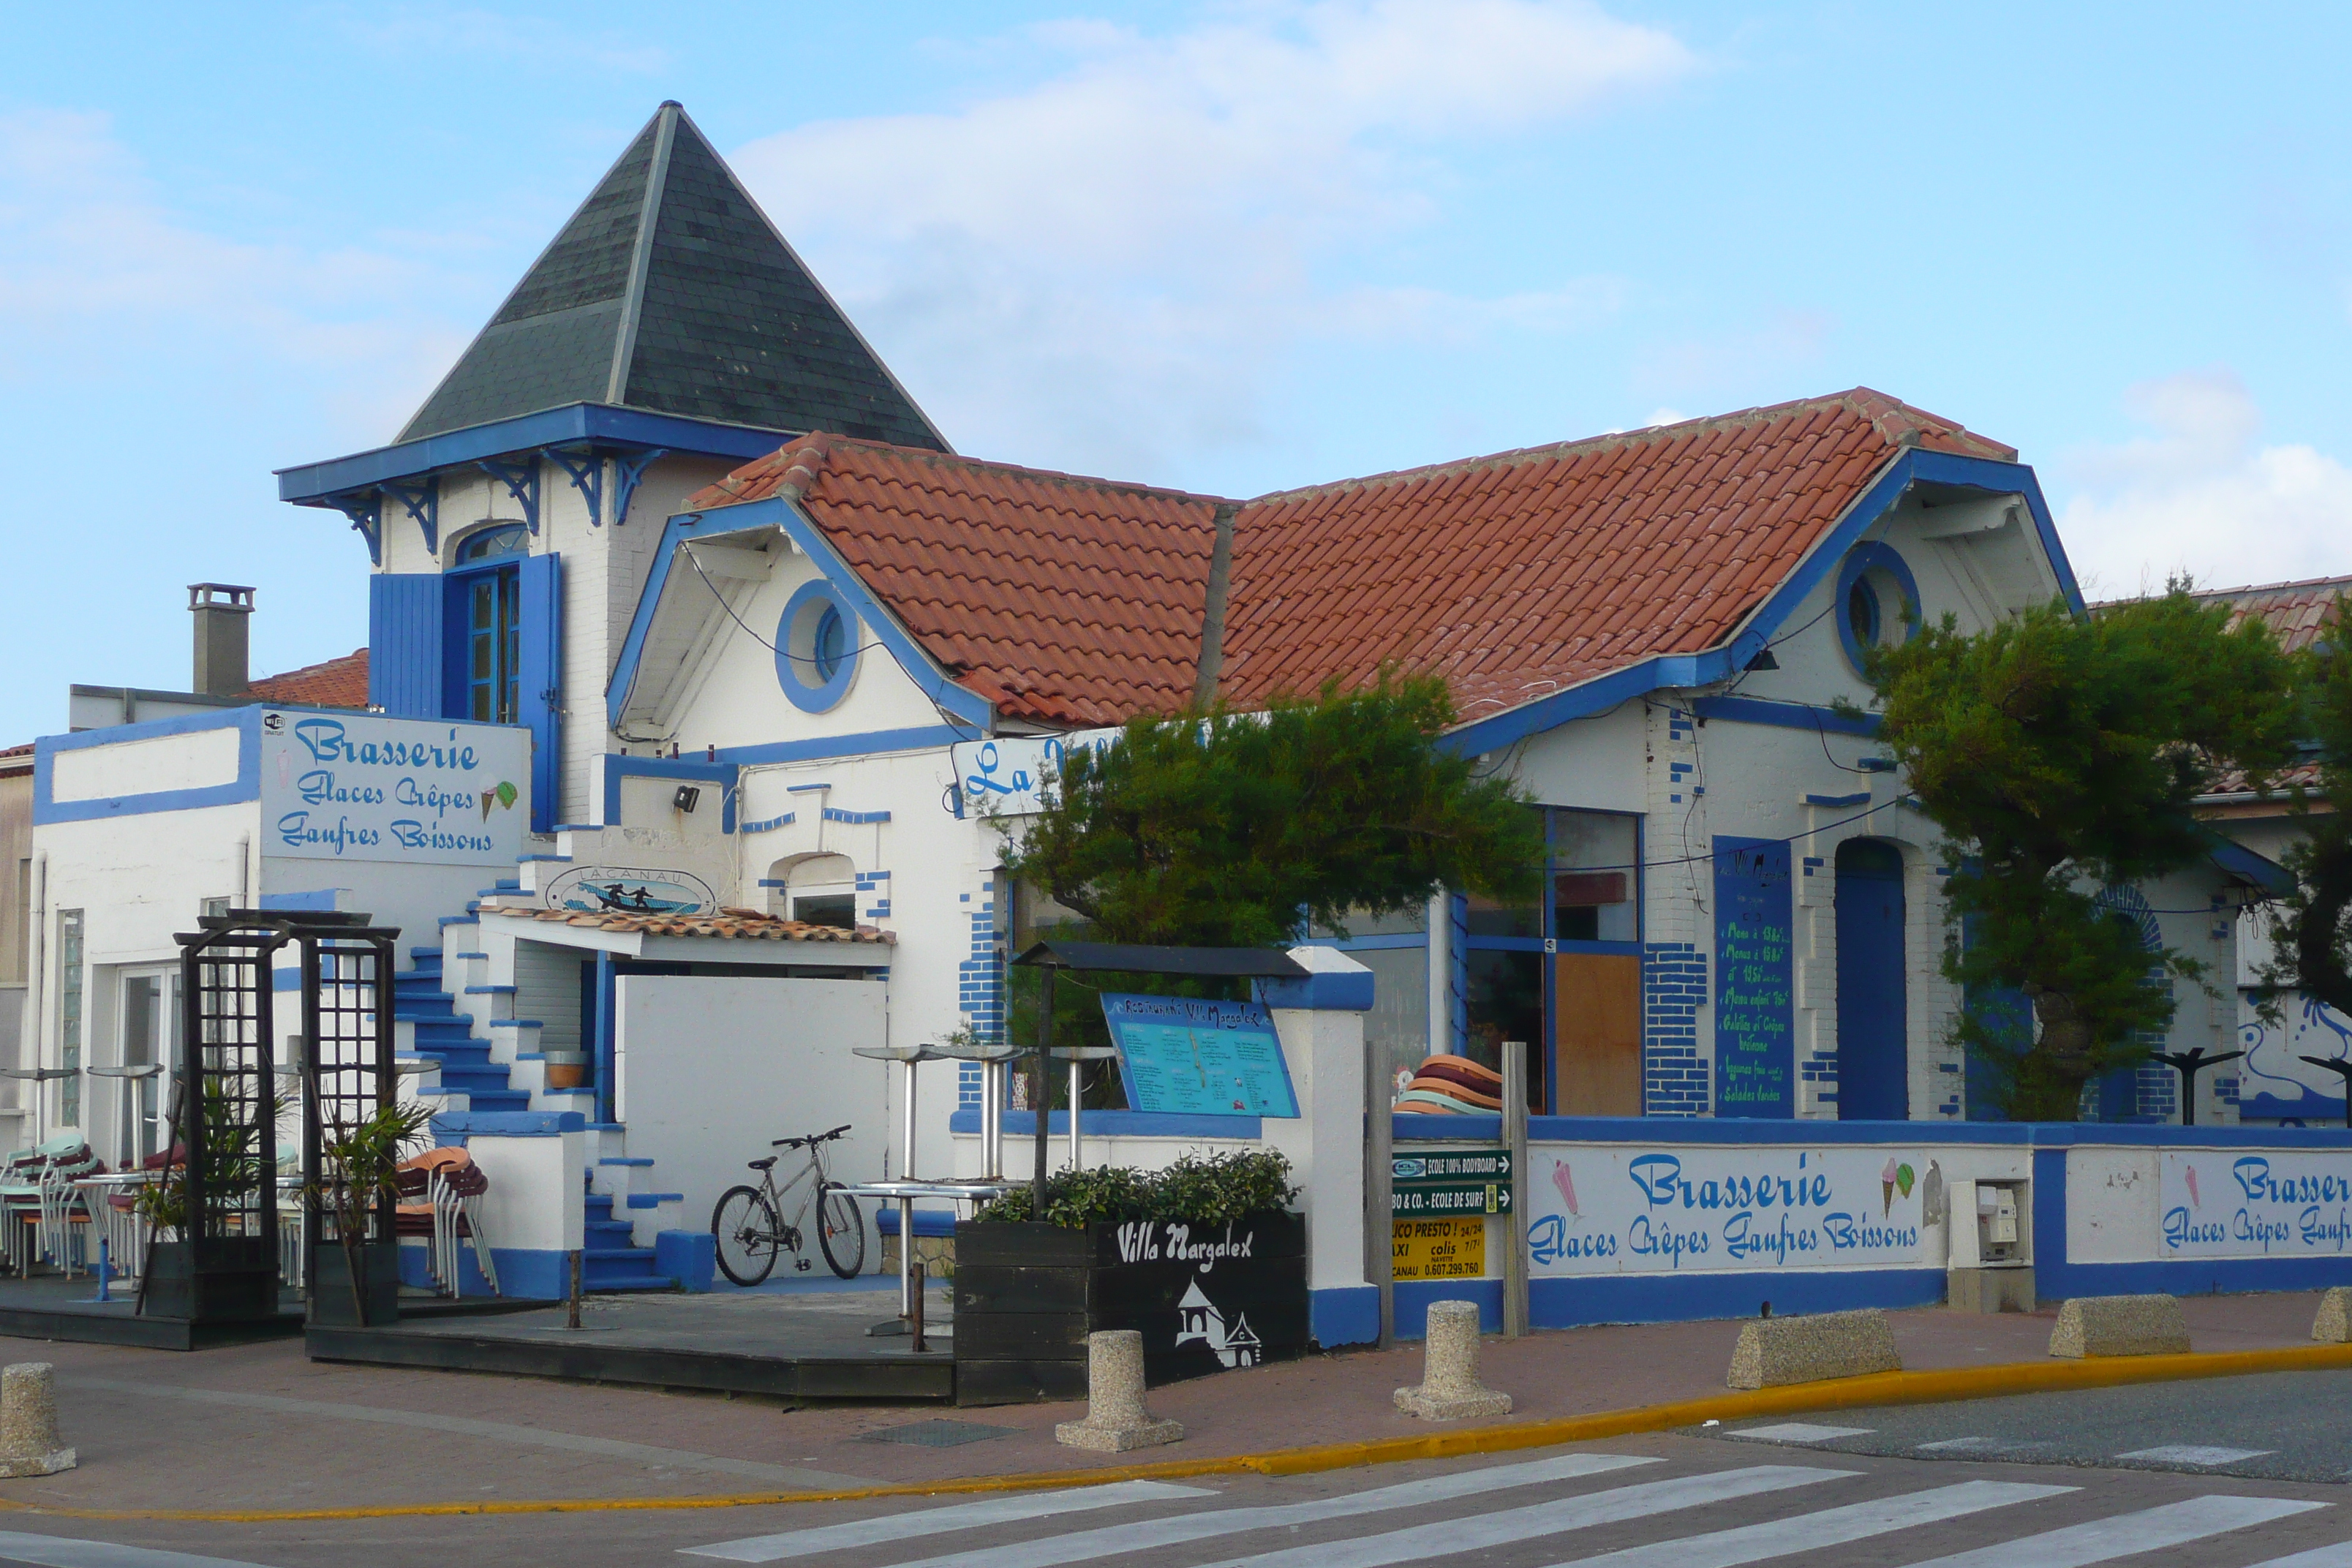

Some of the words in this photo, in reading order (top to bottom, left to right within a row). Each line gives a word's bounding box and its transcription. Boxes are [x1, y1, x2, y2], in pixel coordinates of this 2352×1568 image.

[295, 717, 480, 770] Brasserie
[966, 742, 1036, 796] La
[298, 769, 386, 806] Glaces
[395, 777, 475, 818] Crêpes
[277, 810, 382, 856] Gaufres
[390, 819, 494, 851] Boissons
[580, 869, 681, 883] LACANAU
[1428, 1158, 1445, 1175] ECOLE
[1446, 1158, 1462, 1174] 100%
[1462, 1157, 1497, 1173] BODYBOARD
[1629, 1152, 1832, 1212] Brasserie
[1403, 1193, 1410, 1209] &
[1431, 1192, 1452, 1208] ECOLE
[1454, 1192, 1463, 1207] DE
[1465, 1191, 1484, 1207] SURF
[1117, 1221, 1158, 1263] Villa
[1166, 1218, 1254, 1273] Margalex
[1414, 1222, 1451, 1237] PRESTO
[1431, 1240, 1456, 1255] colis
[1527, 1214, 1618, 1265] Glaces
[1628, 1214, 1711, 1268] Crêpes
[1722, 1211, 1820, 1265] Gaufres
[1823, 1211, 1919, 1253] Boissons
[2162, 1206, 2225, 1248] Glaces
[2233, 1207, 2290, 1253] Crêpes
[1425, 1262, 1479, 1276] 0.607.299.760
